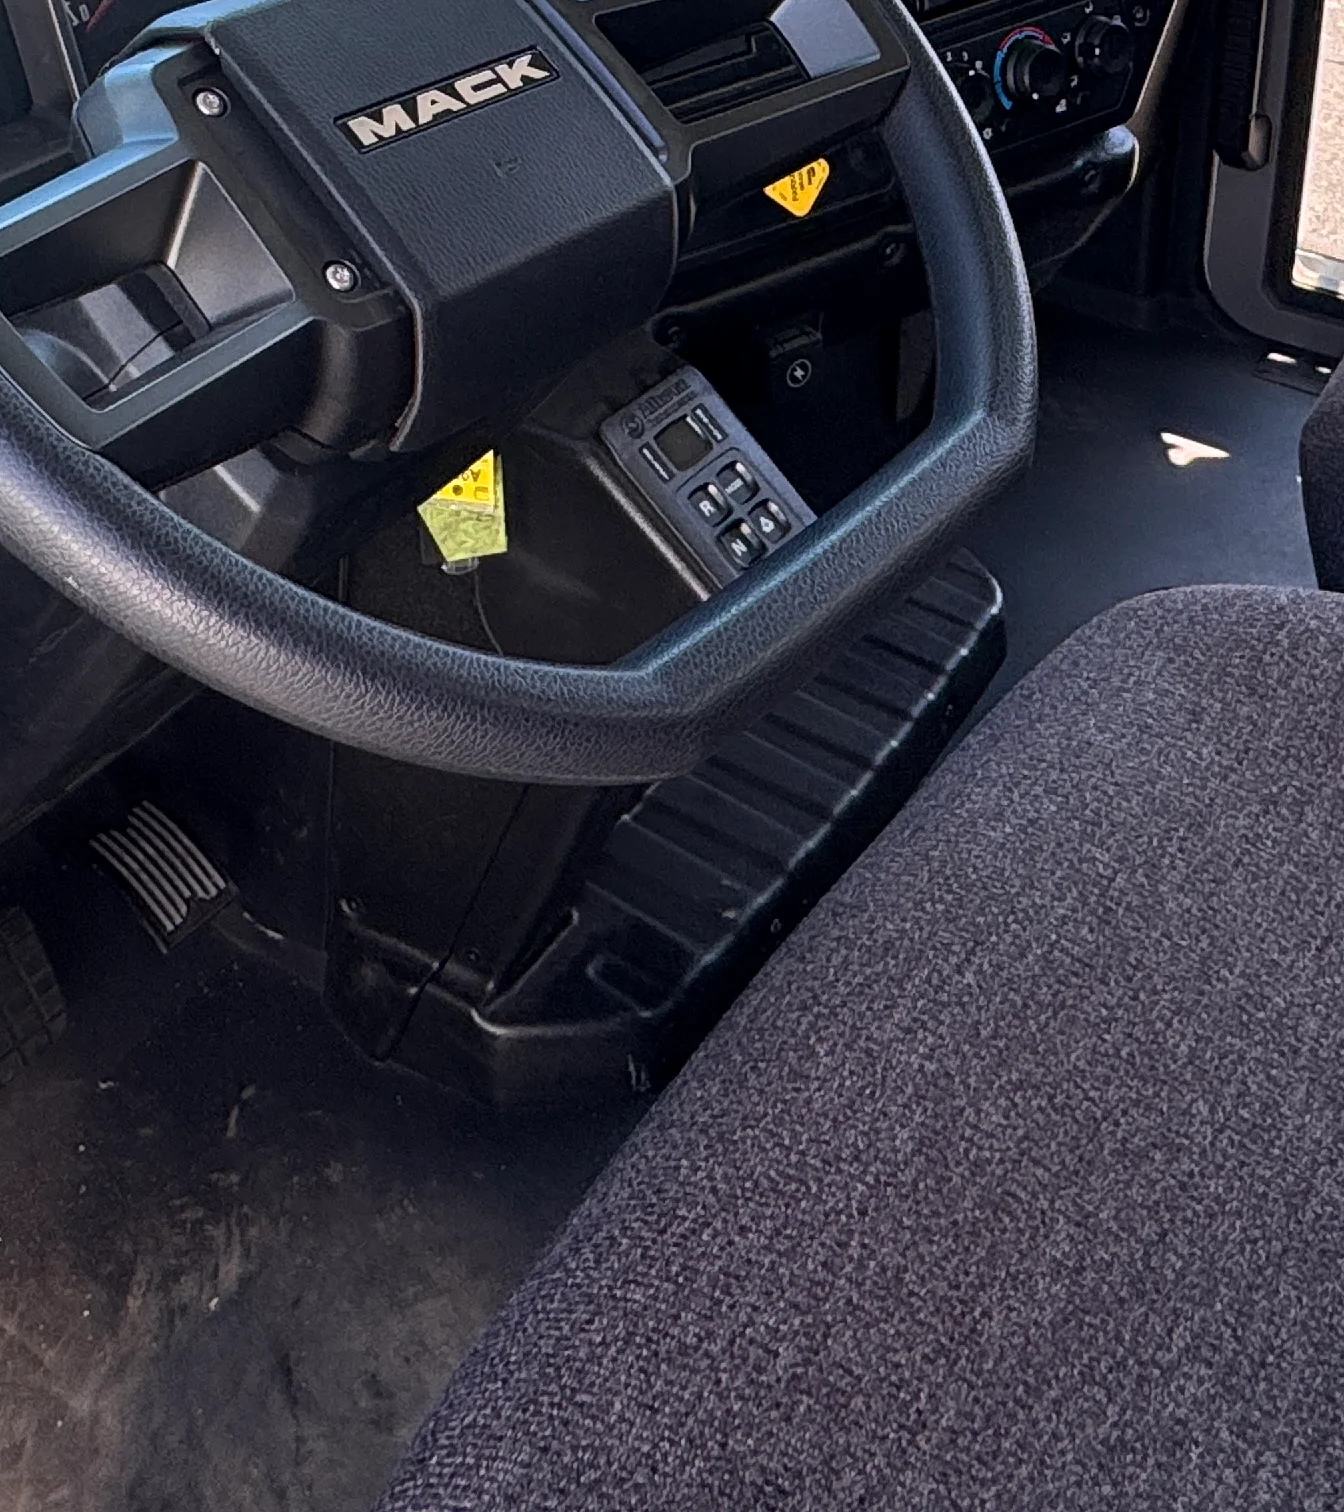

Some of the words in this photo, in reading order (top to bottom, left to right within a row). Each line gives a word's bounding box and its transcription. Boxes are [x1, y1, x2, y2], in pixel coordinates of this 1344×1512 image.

[78, 4, 90, 22] 0
[347, 54, 551, 147] MACK
[698, 499, 717, 518] R
[730, 539, 748, 557] N
